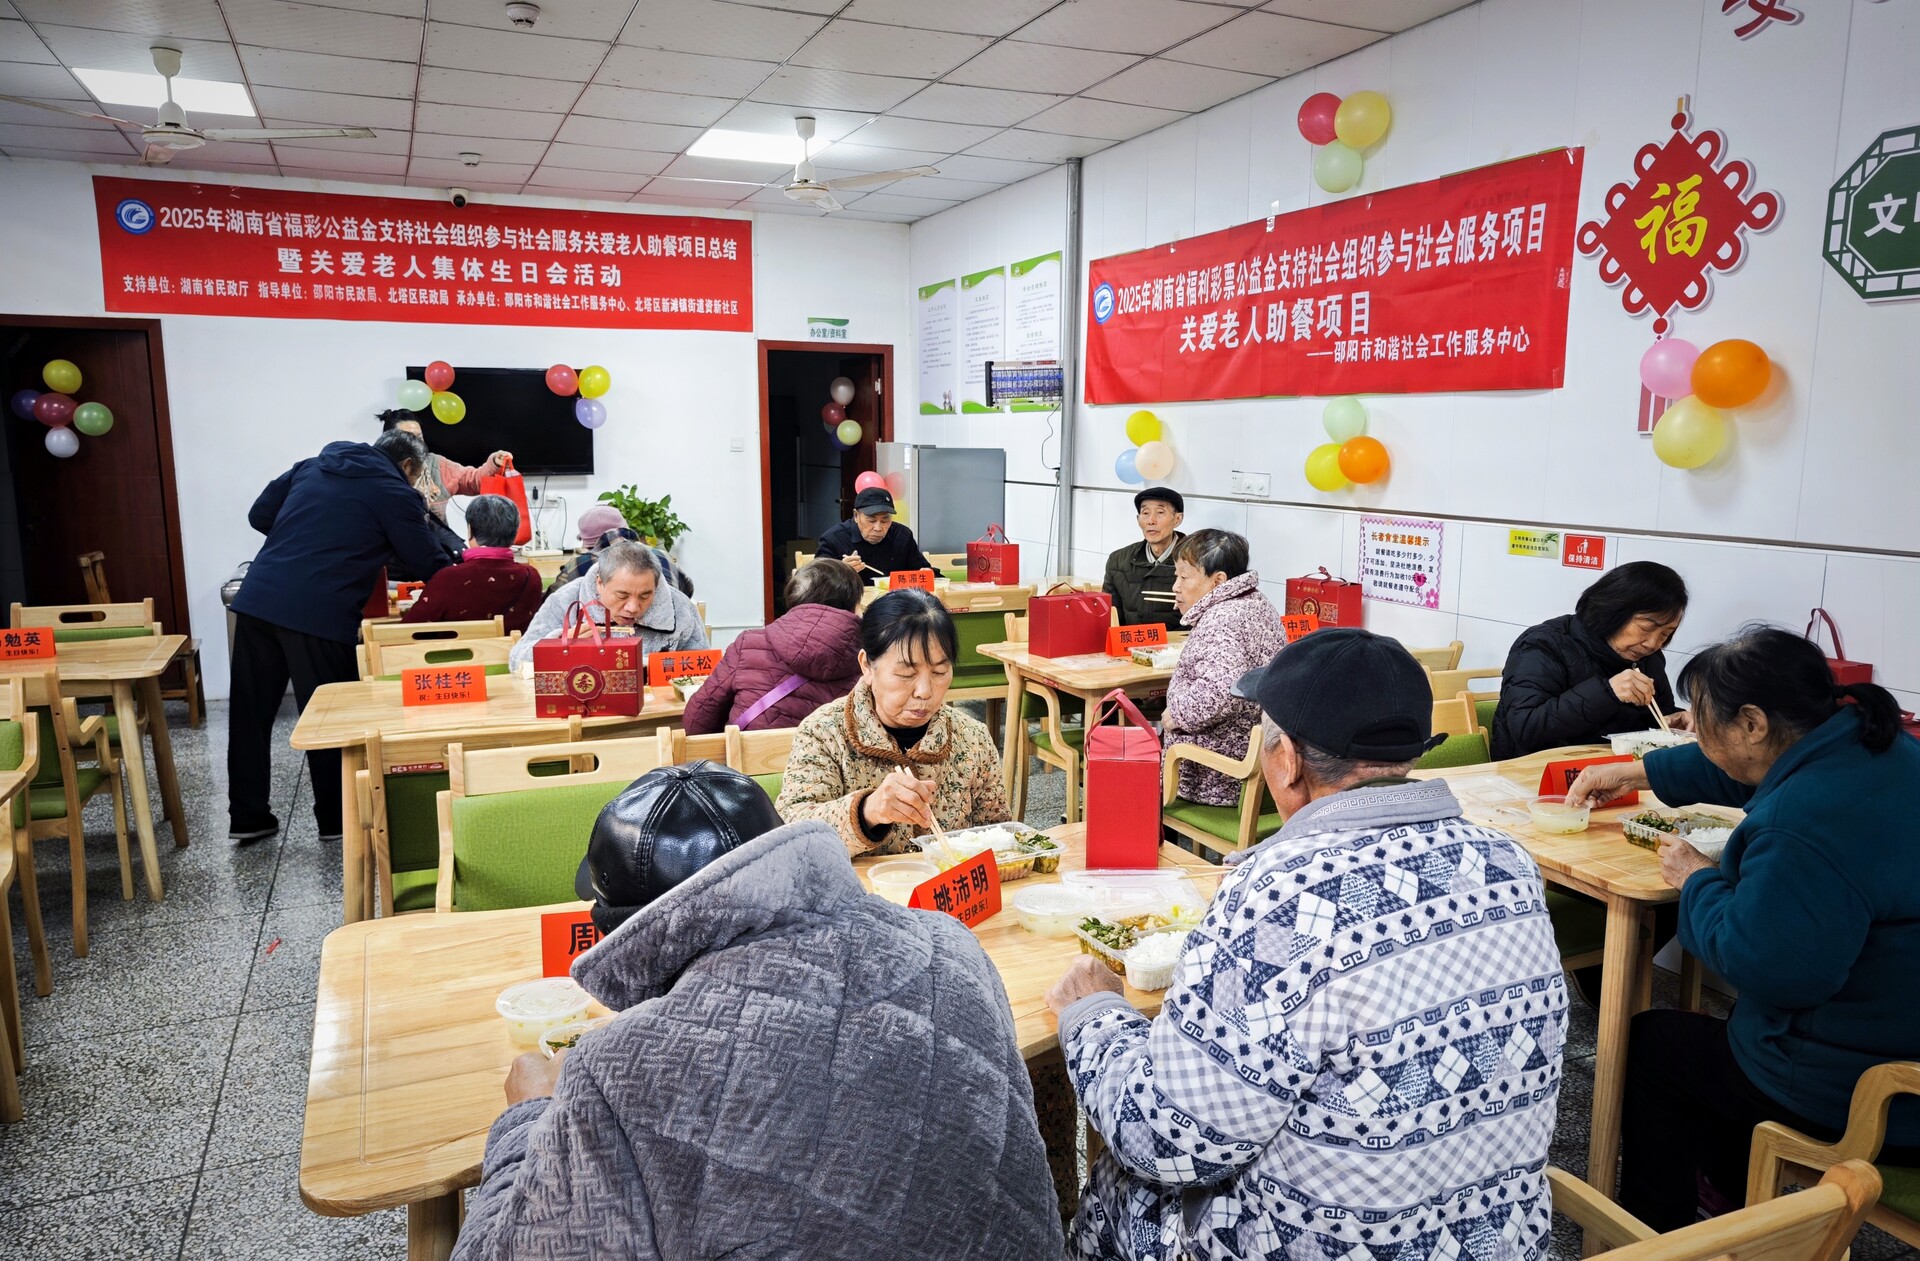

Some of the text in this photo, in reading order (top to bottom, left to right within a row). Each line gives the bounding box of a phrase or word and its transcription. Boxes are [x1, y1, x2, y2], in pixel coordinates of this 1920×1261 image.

[1634, 174, 1707, 264] 福
[1864, 193, 1920, 238] 文
[160, 206, 737, 261] 2025年湖南省福彩公益金支持社会组织参与社会服务关爱老人助餐项目总结
[277, 247, 622, 287] 暨关爱老人集体生日会活动
[1117, 203, 1547, 315] 2025年湖南省福利彩票公益金支持社会组织参与社会服务项目
[123, 274, 249, 297] 支持单位：湖南省民政厅
[1179, 291, 1370, 353] 关爱老人助餐项目
[1371, 531, 1430, 546] 长者食堂温馨提示
[1568, 553, 1598, 565] 保持清洁
[0, 632, 41, 647] 勉英
[1120, 628, 1159, 643] 颜志明
[1282, 619, 1311, 632] 中凯
[661, 655, 712, 672] 曹长松
[415, 671, 472, 690] 张桂华
[933, 864, 989, 912] 姚沛明
[568, 922, 599, 955] 周
